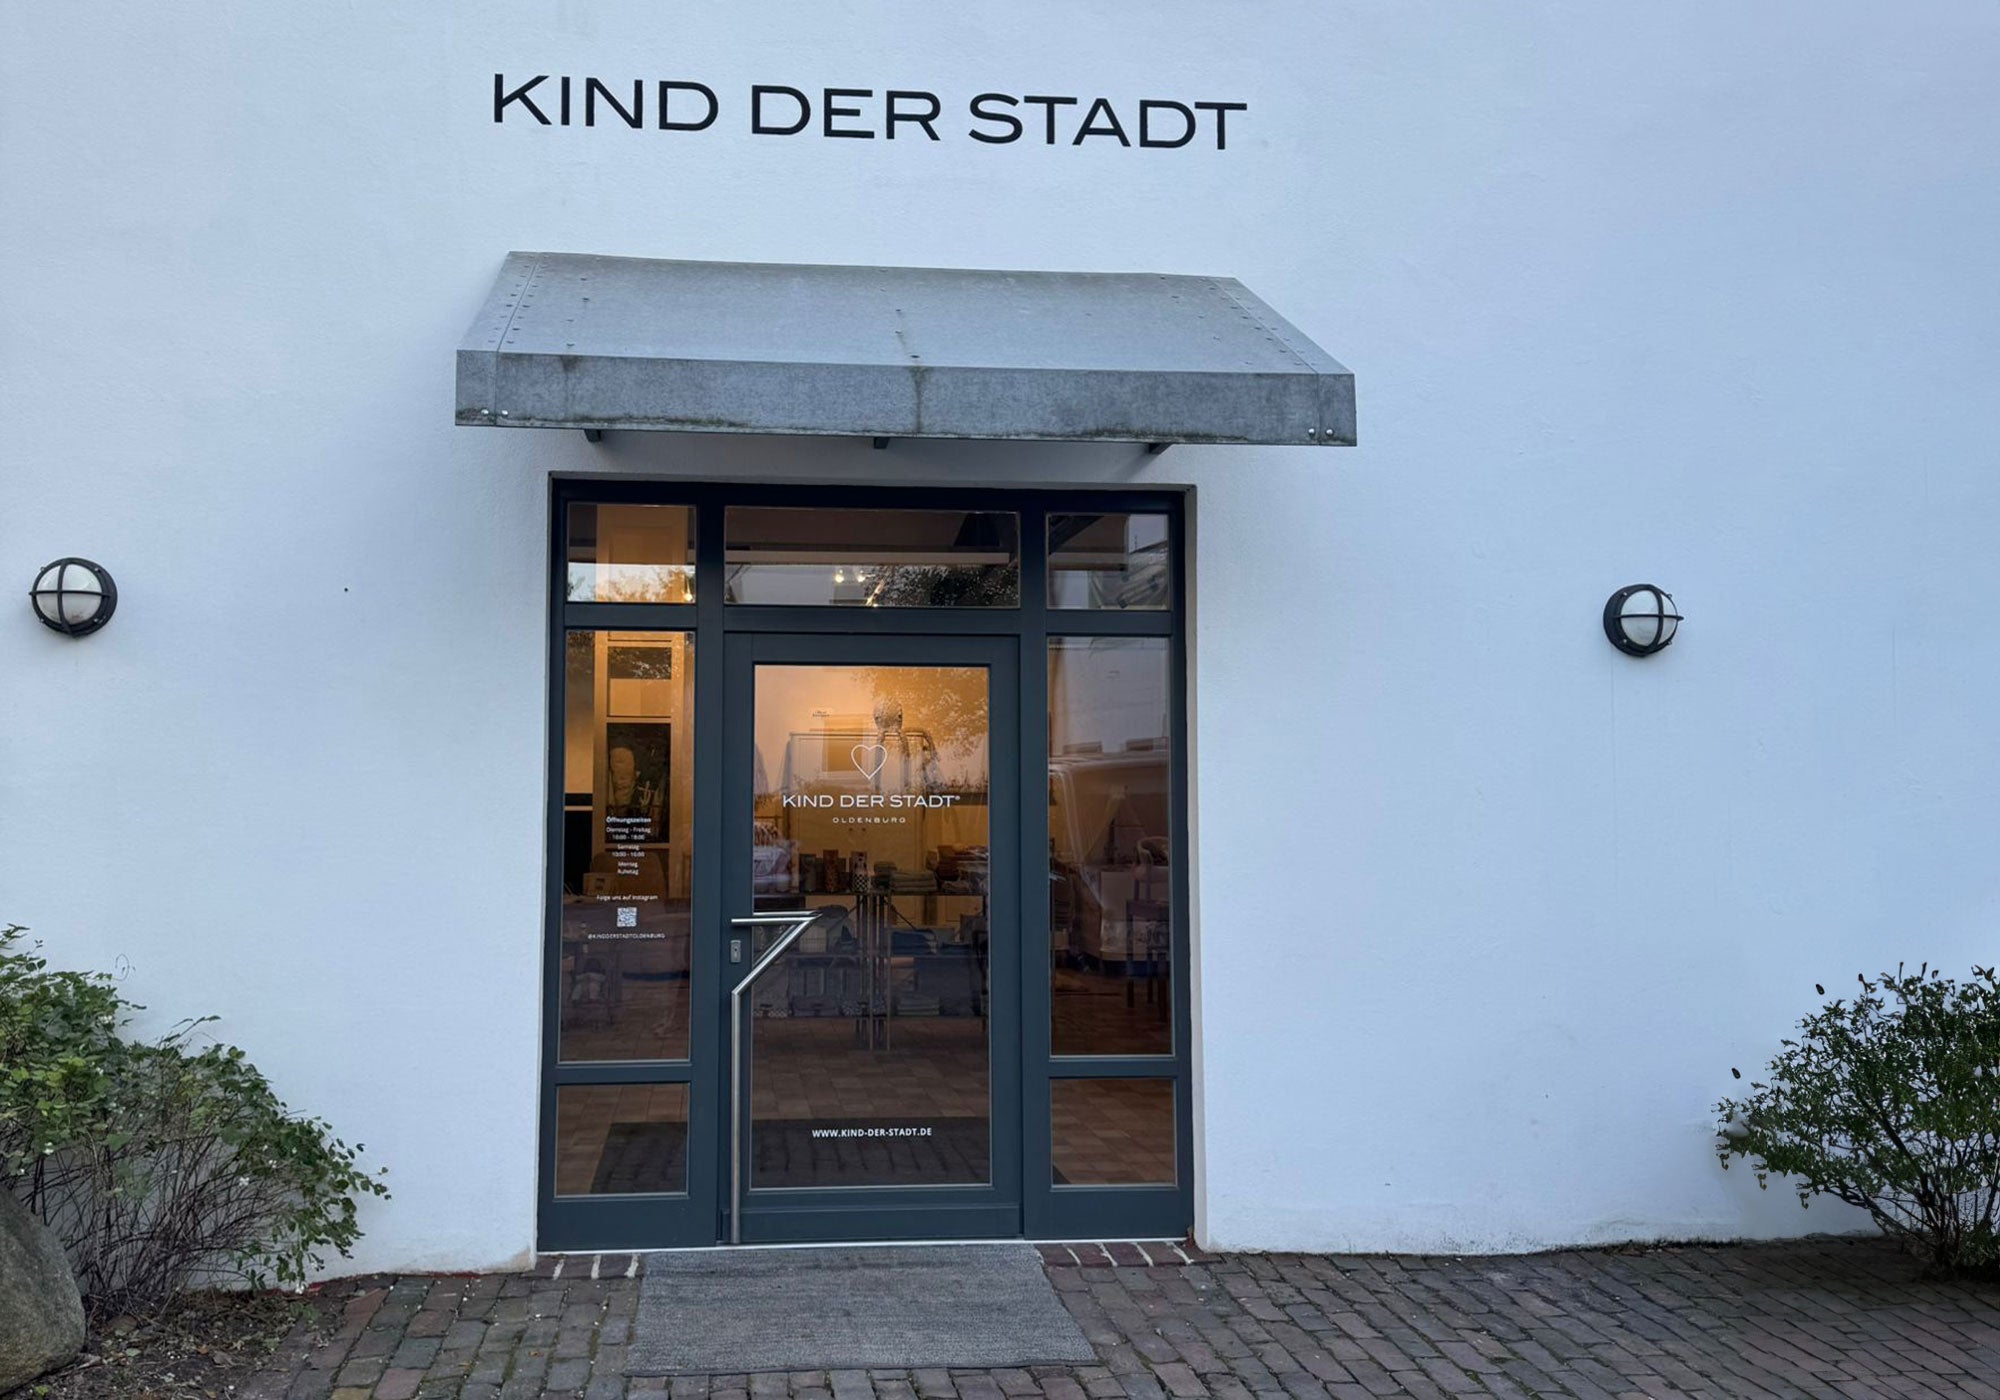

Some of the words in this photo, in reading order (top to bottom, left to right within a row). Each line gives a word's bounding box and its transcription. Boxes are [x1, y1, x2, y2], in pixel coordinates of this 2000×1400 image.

[494, 73, 719, 132] KIND
[751, 84, 941, 141] DER
[968, 92, 1248, 151] STADT
[782, 794, 834, 808] KIND
[840, 795, 885, 808] DER
[606, 816, 652, 824] Öffnungszeiten
[832, 816, 907, 824] OLDENBURG
[812, 1127, 932, 1138] WWW.KIND-DER-STADT.DE
